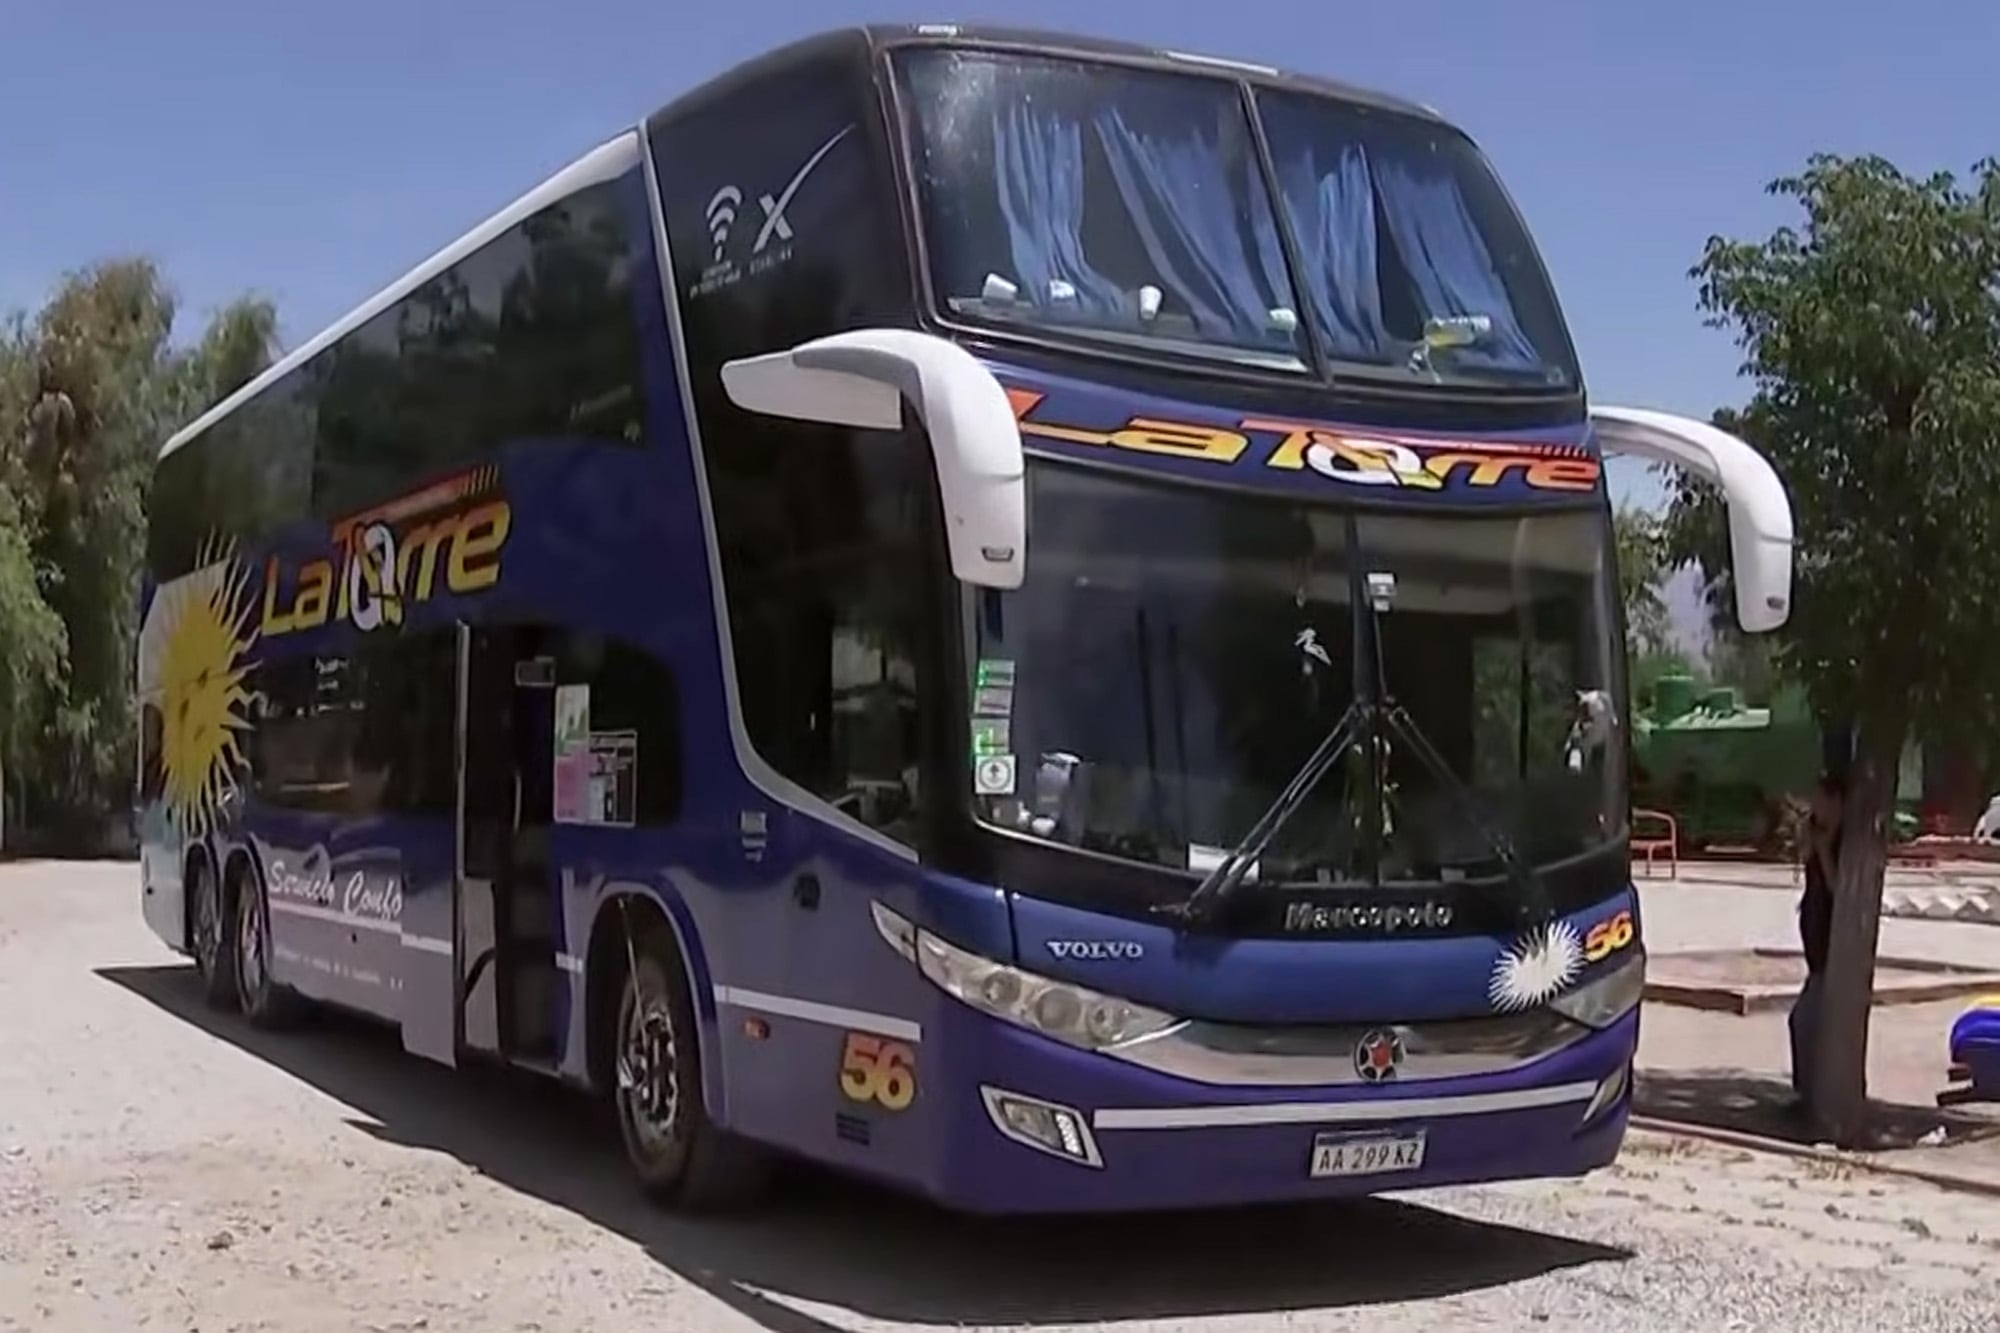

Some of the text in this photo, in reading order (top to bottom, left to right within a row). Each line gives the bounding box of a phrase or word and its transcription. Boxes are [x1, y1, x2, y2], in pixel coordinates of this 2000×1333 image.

[1284, 902, 1453, 932] Marcopolo
[1047, 941, 1143, 958] VOLVO
[1585, 910, 1633, 963] 56
[841, 1033, 915, 1110] 56
[1319, 1148, 1344, 1169] AA
[1352, 1145, 1390, 1169] 299
